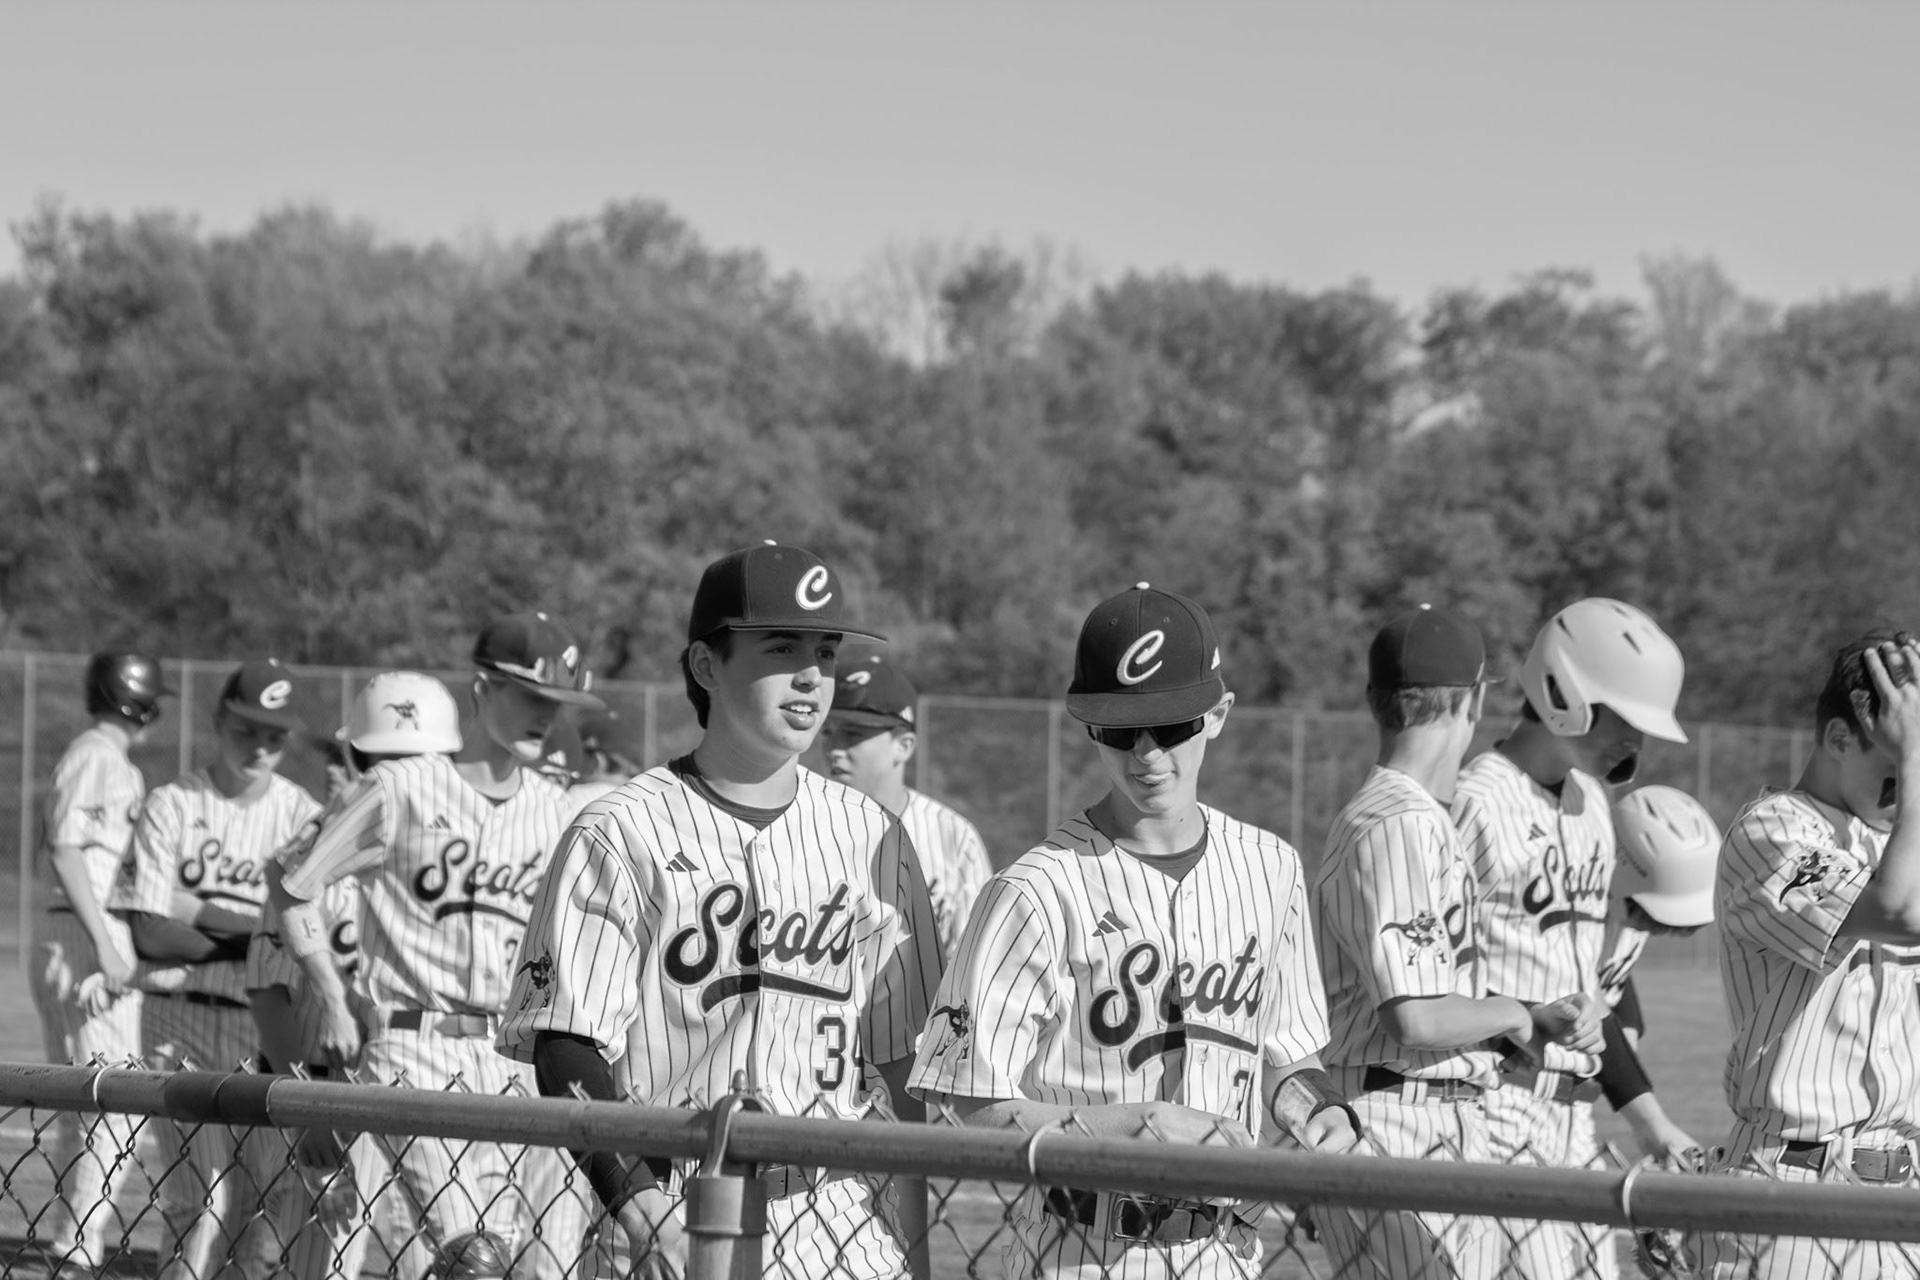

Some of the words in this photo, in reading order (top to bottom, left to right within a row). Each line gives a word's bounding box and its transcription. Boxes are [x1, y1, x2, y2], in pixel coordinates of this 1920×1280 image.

[796, 565, 833, 611] C
[1117, 630, 1165, 686] C
[662, 881, 856, 987] Scots
[1088, 934, 1265, 1047] Scots
